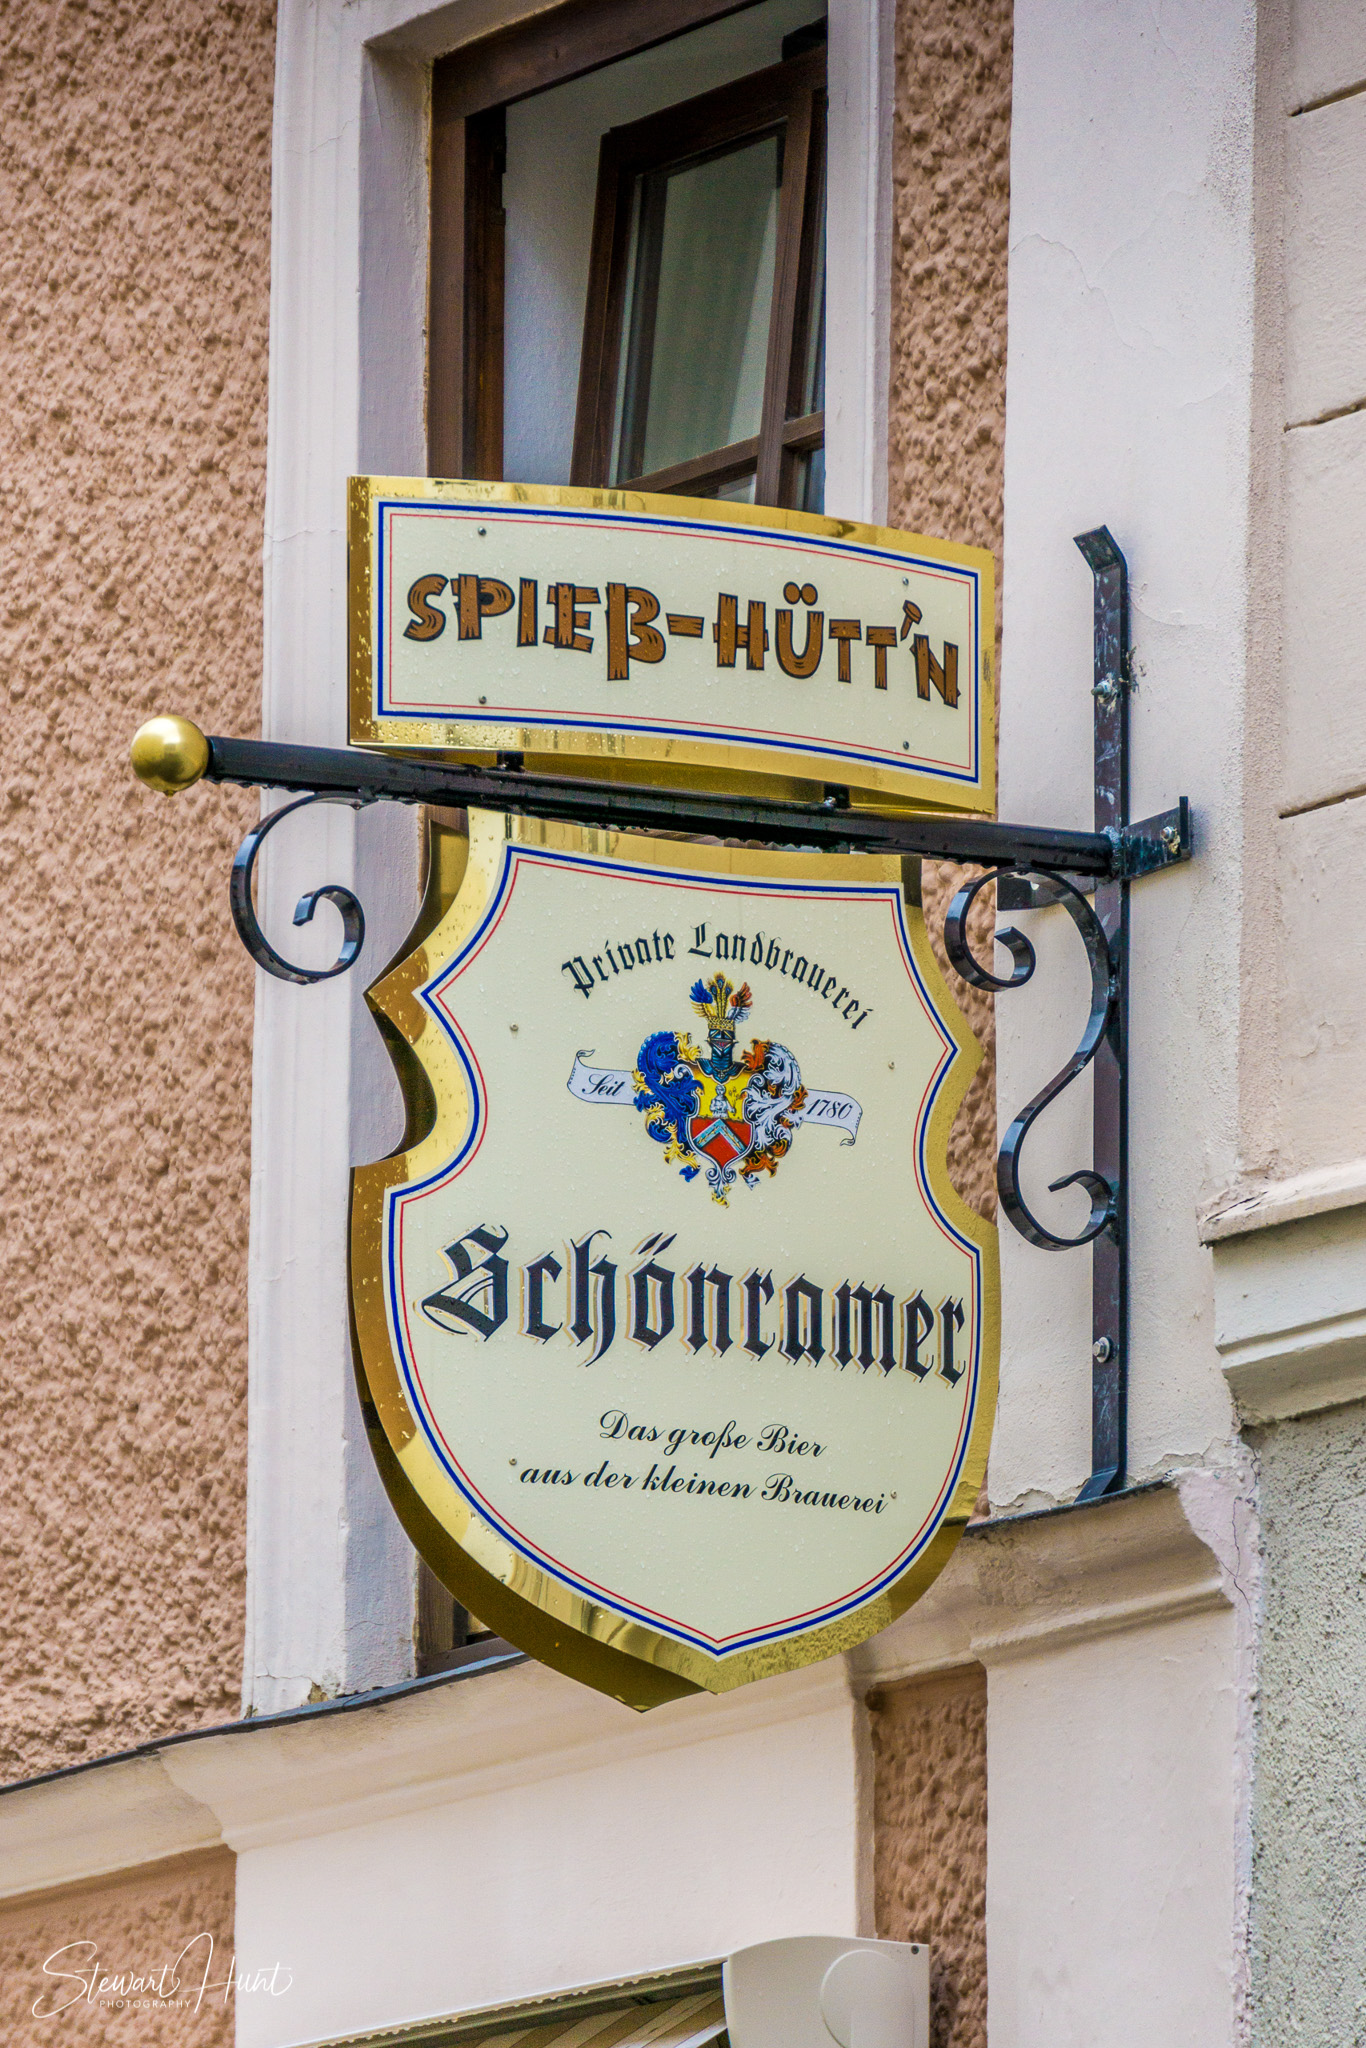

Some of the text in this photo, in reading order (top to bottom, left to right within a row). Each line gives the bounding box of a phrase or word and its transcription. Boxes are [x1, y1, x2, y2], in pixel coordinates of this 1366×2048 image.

[561, 921, 874, 1029] Private Landbrauerei
[581, 1073, 625, 1097] Seit
[805, 1098, 853, 1120] 1780
[413, 1222, 967, 1389] Schönramer
[600, 1409, 828, 1459] Das große Bier
[519, 1461, 889, 1514] aus der kleinen Brauerei
